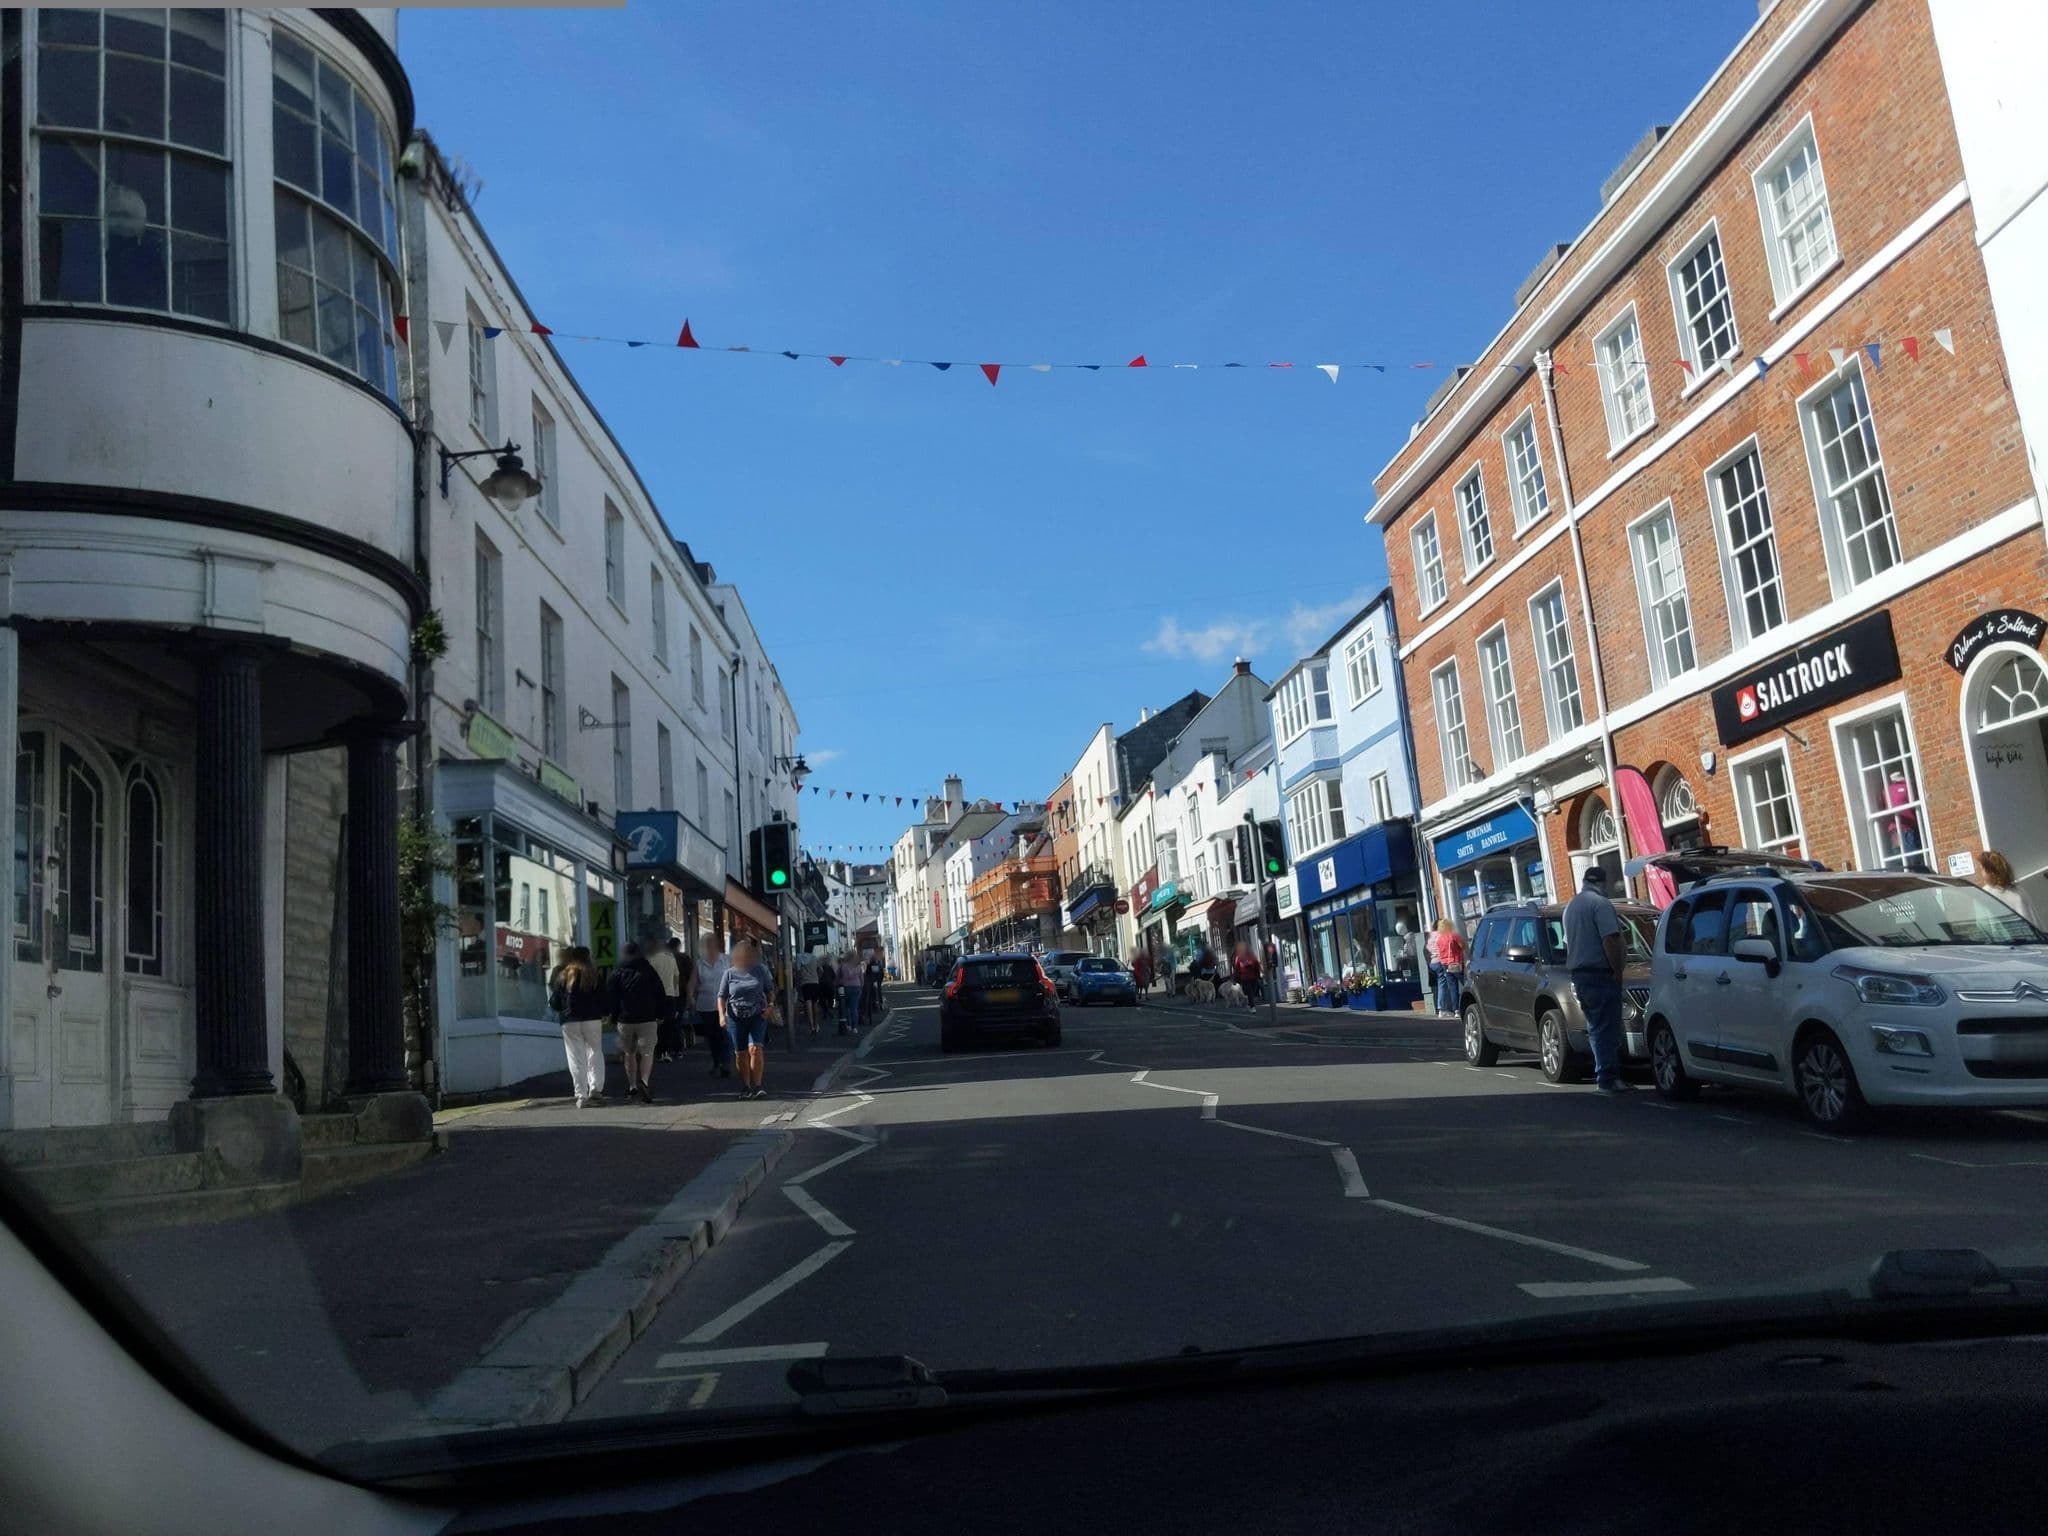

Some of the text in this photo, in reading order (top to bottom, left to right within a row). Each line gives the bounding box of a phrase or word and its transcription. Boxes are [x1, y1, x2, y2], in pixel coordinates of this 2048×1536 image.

[1953, 615, 2038, 668] Welcome to Saltrock
[1756, 643, 1852, 712] SALTROCK
[1456, 831, 1508, 858] SMITH BANWELL
[1466, 821, 1492, 841] FORTNAM
